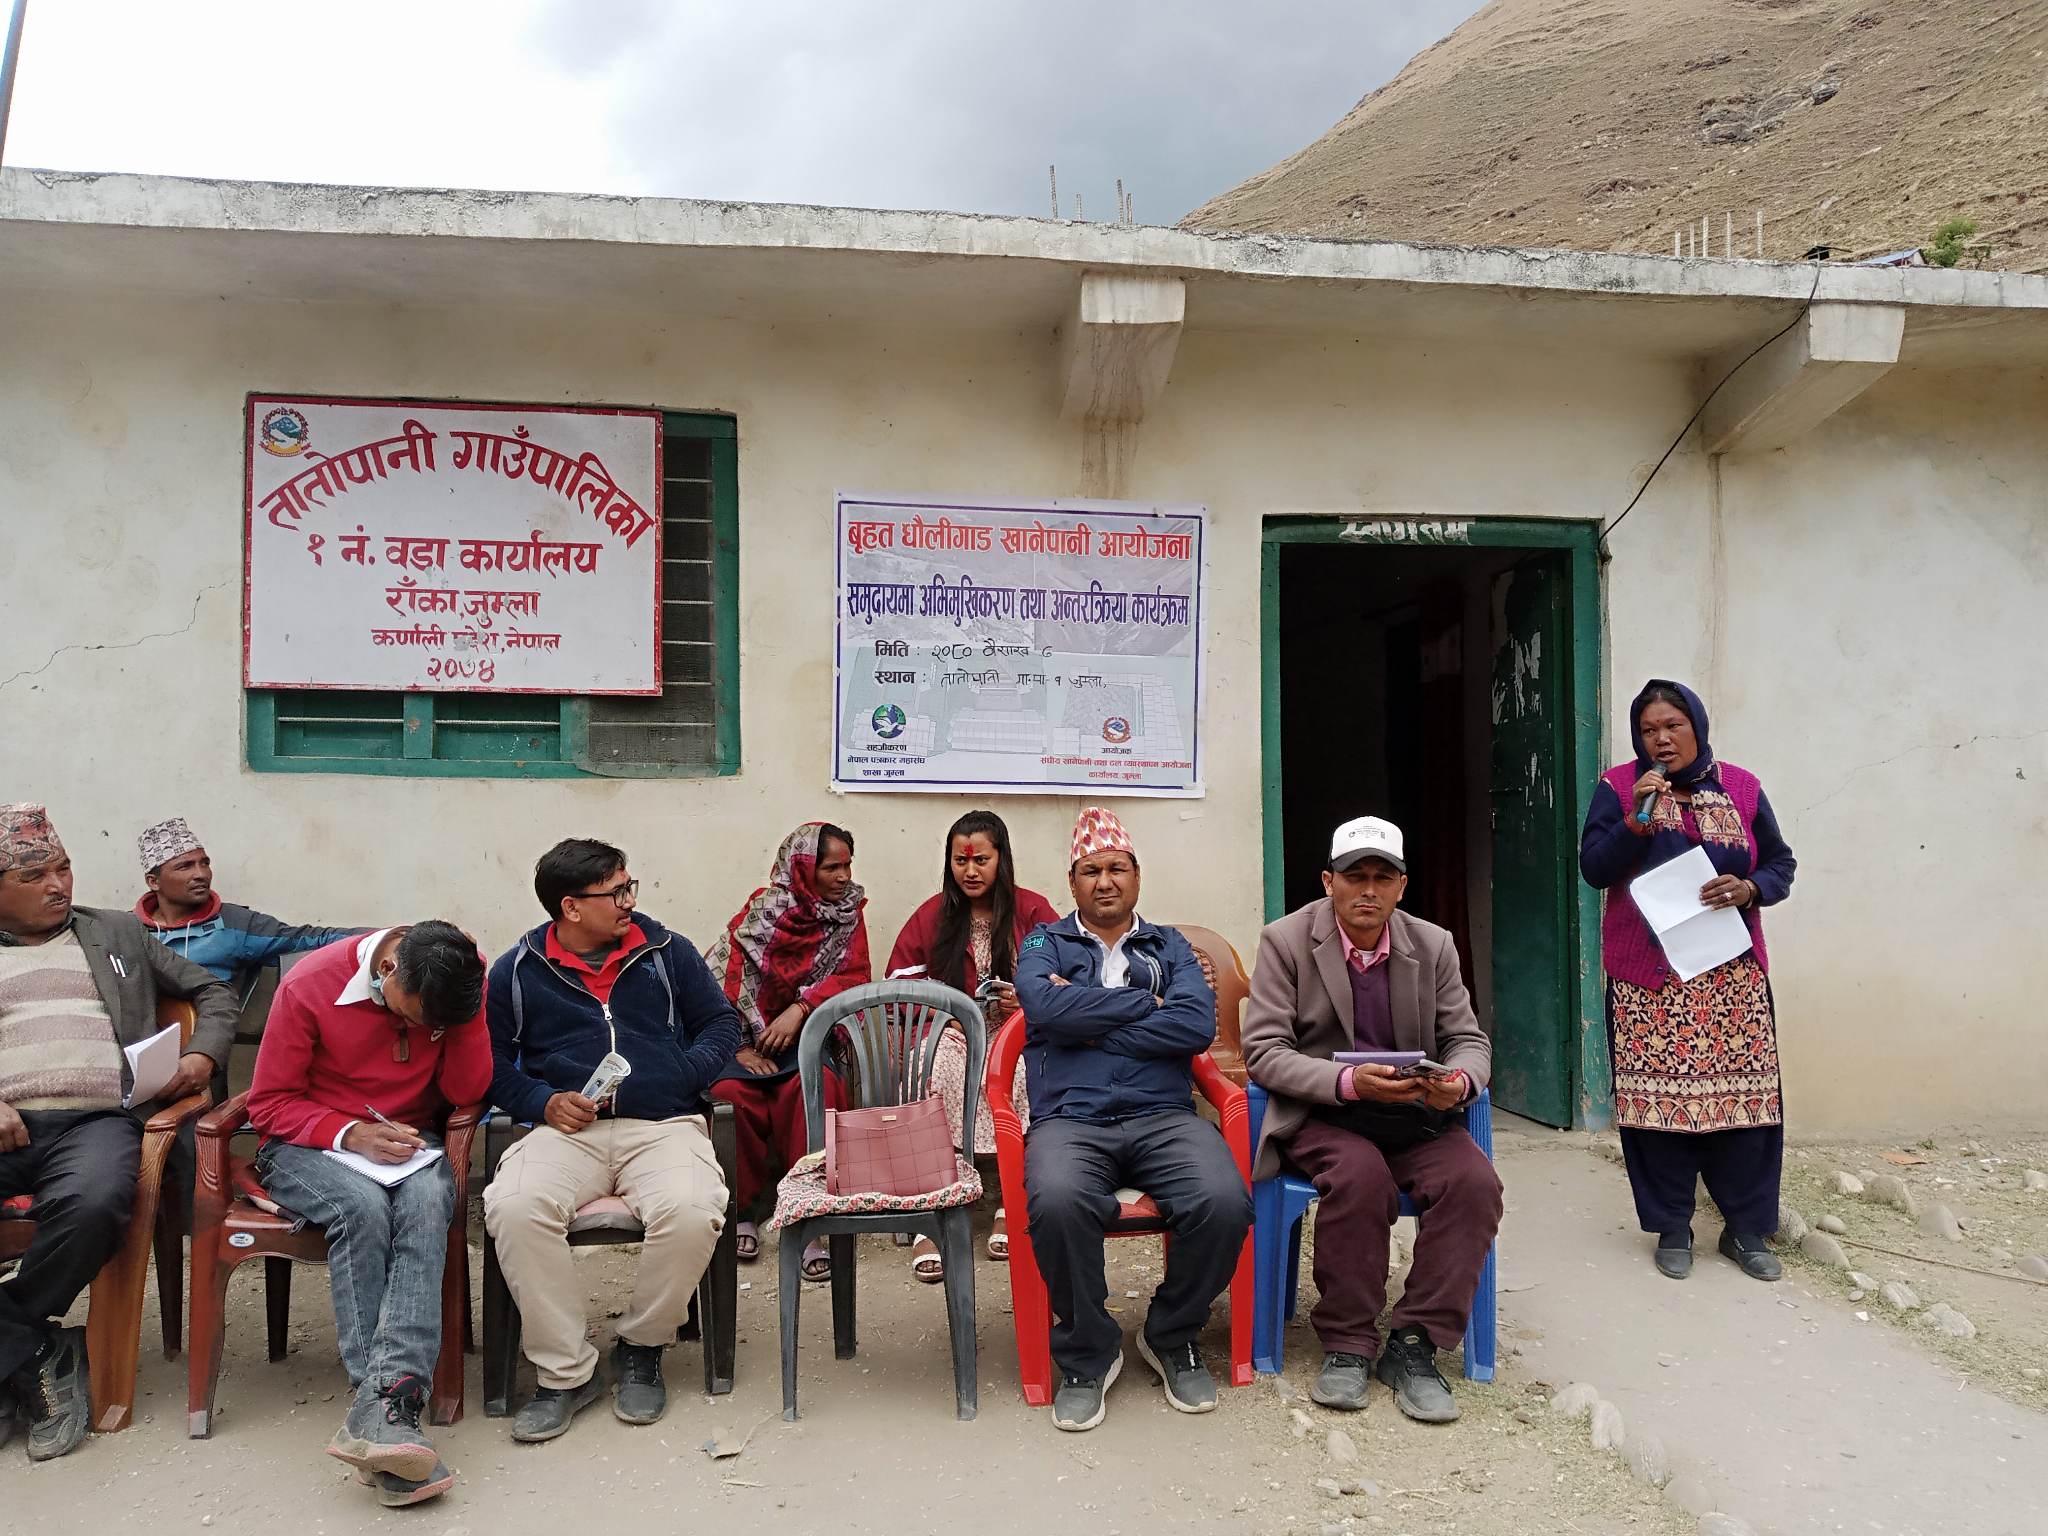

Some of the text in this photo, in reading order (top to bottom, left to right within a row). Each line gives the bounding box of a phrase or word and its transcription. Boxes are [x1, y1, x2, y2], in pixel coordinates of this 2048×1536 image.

[258, 419, 655, 549] तातोपानी गाउँपालिका
[307, 533, 326, 567] १
[384, 536, 450, 573] वडा
[458, 530, 603, 579] कार्यालय
[848, 521, 895, 554] बृहत
[1000, 520, 1091, 556] खानेपानी
[1098, 525, 1192, 560] आयोजना
[847, 583, 915, 625] समुदायमा
[1020, 589, 1047, 621] तथा
[1051, 580, 1128, 624] अन्तरक्रिया
[1132, 585, 1190, 627] कार्यक्रम
[371, 623, 447, 652] कर्णाली
